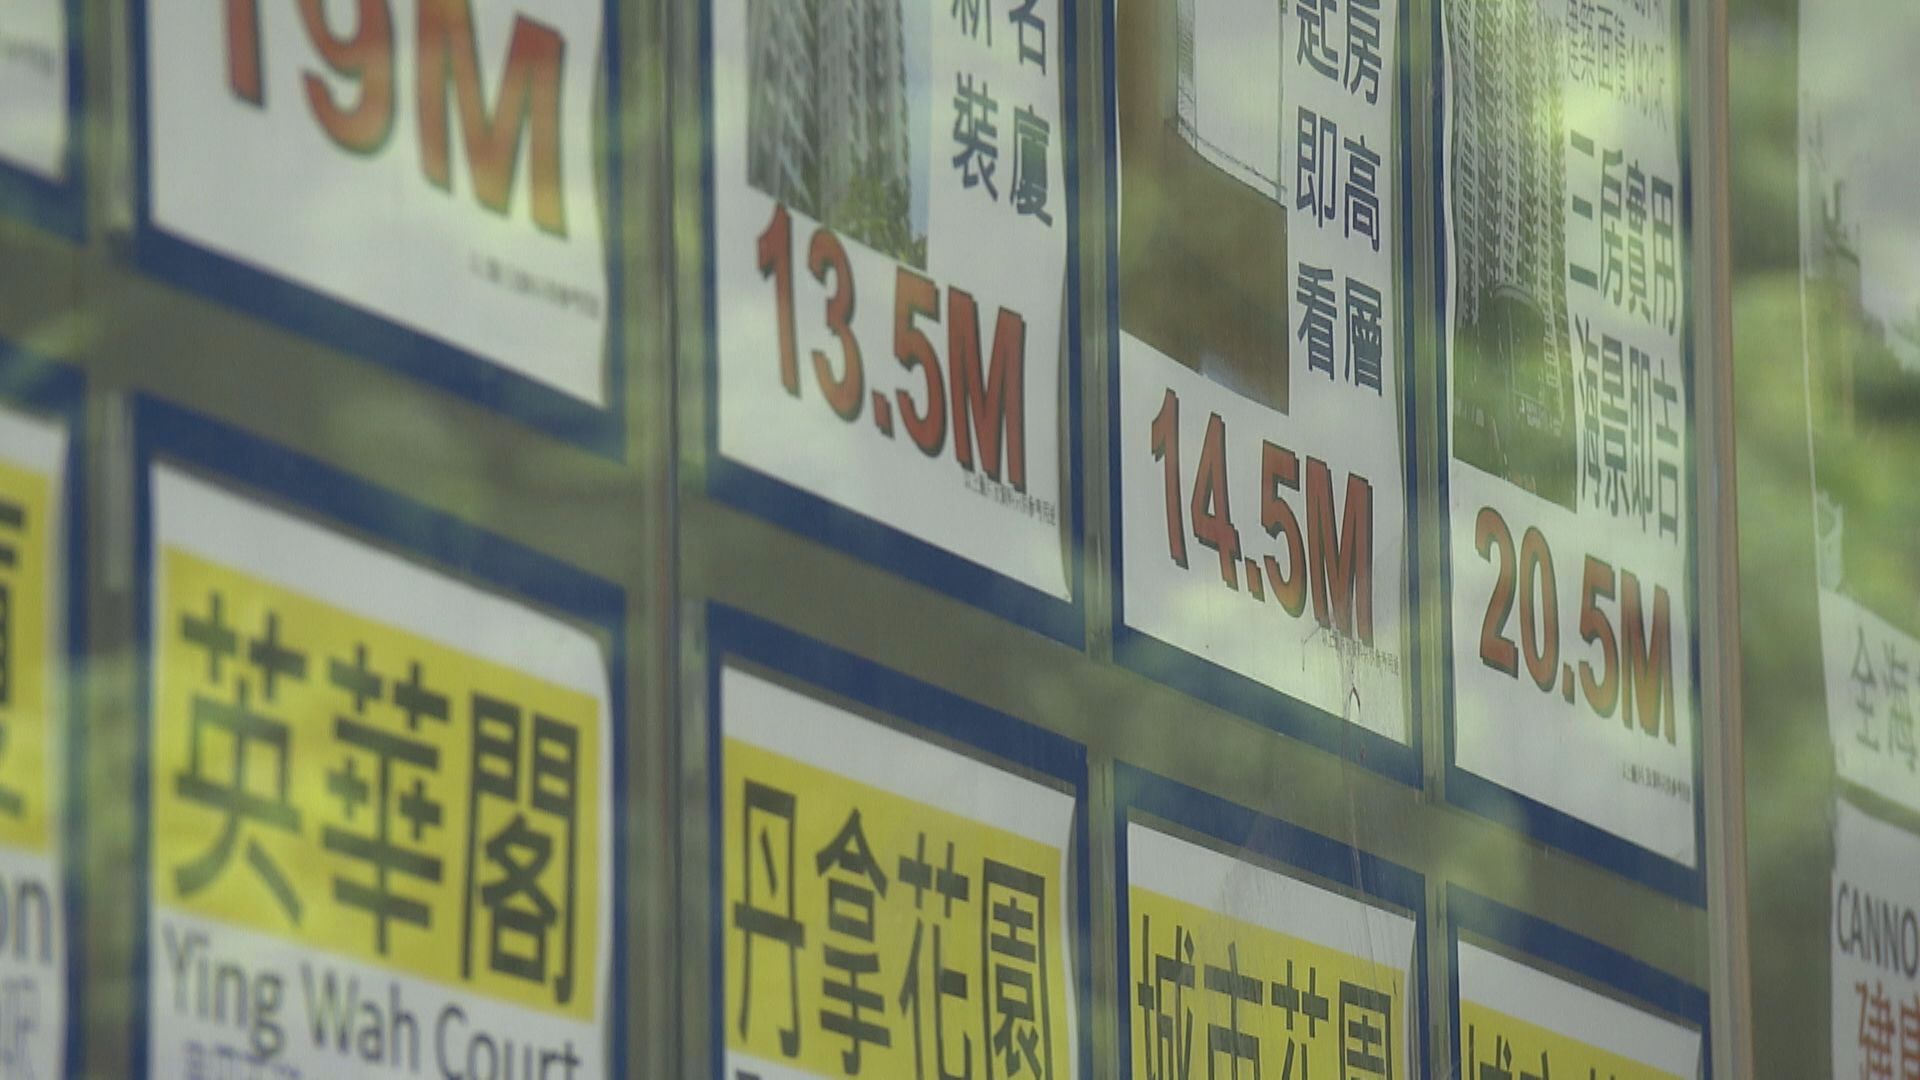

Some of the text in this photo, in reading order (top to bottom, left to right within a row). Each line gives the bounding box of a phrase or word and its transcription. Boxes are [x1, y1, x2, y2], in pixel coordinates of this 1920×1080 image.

[757, 202, 1026, 495] 13.5M
[1151, 387, 1374, 649] 14.5M
[1475, 506, 1677, 747] 20.5M
[174, 592, 581, 1006] 英華閣
[733, 777, 1055, 1080] 丹拿花園
[165, 922, 287, 1060] Ying
[301, 961, 421, 1074] Wah
